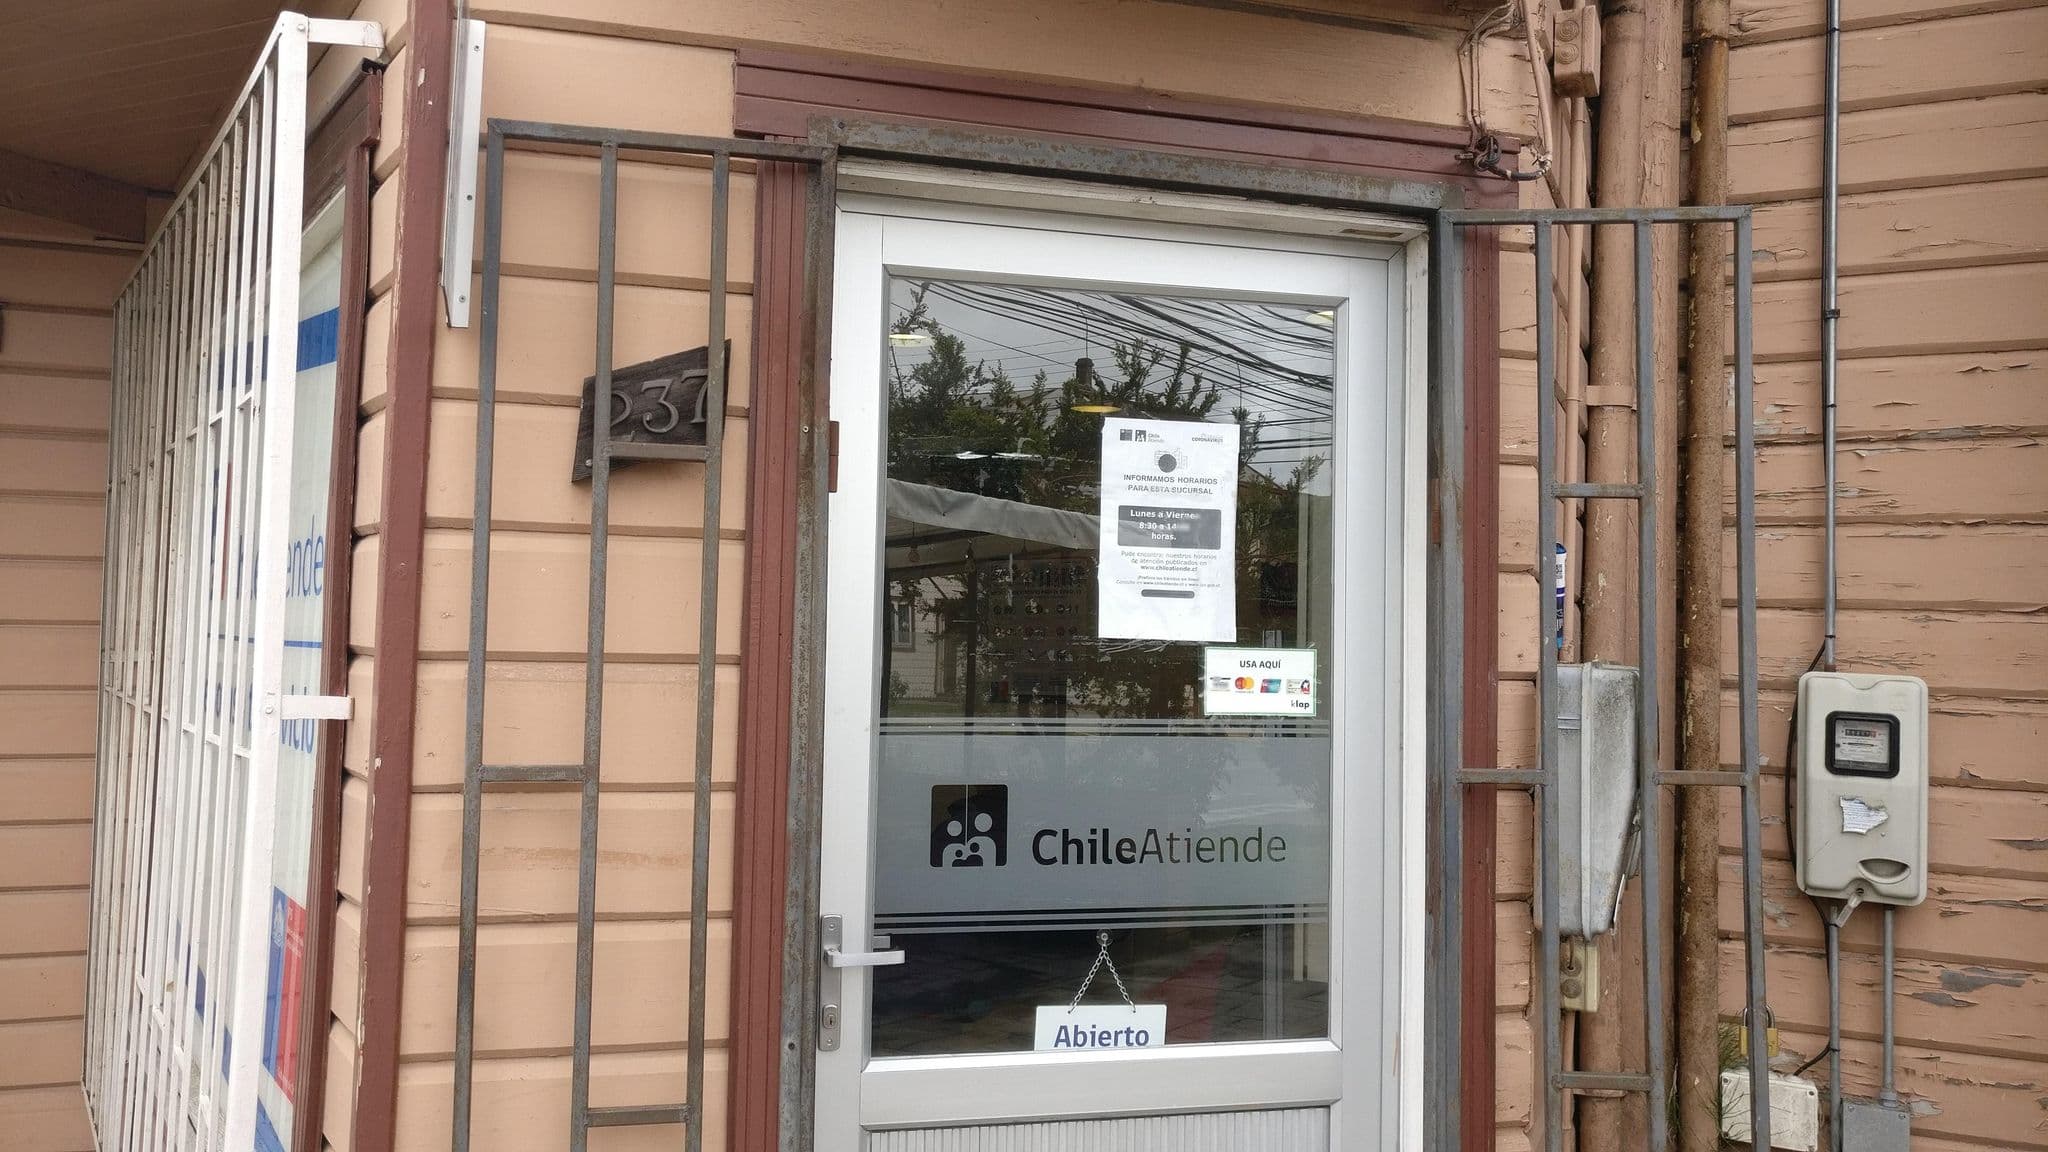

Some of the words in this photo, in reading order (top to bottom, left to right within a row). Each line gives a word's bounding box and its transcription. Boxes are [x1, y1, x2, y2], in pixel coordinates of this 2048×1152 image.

[1123, 474, 1175, 483] INFORMAMOS
[1177, 476, 1218, 485] HORARIOS
[1171, 487, 1213, 495] SUCURSAL
[1130, 509, 1156, 518] Lunes
[1139, 521, 1157, 530] 8:30
[1151, 531, 1177, 541] horas.
[1165, 559, 1198, 567] publicados
[1239, 660, 1257, 668] USA
[1259, 659, 1281, 669] AQUÍ
[1291, 700, 1310, 709] klap
[1032, 827, 1287, 866] ChileAtiende
[1053, 1024, 1150, 1048] Abierto
